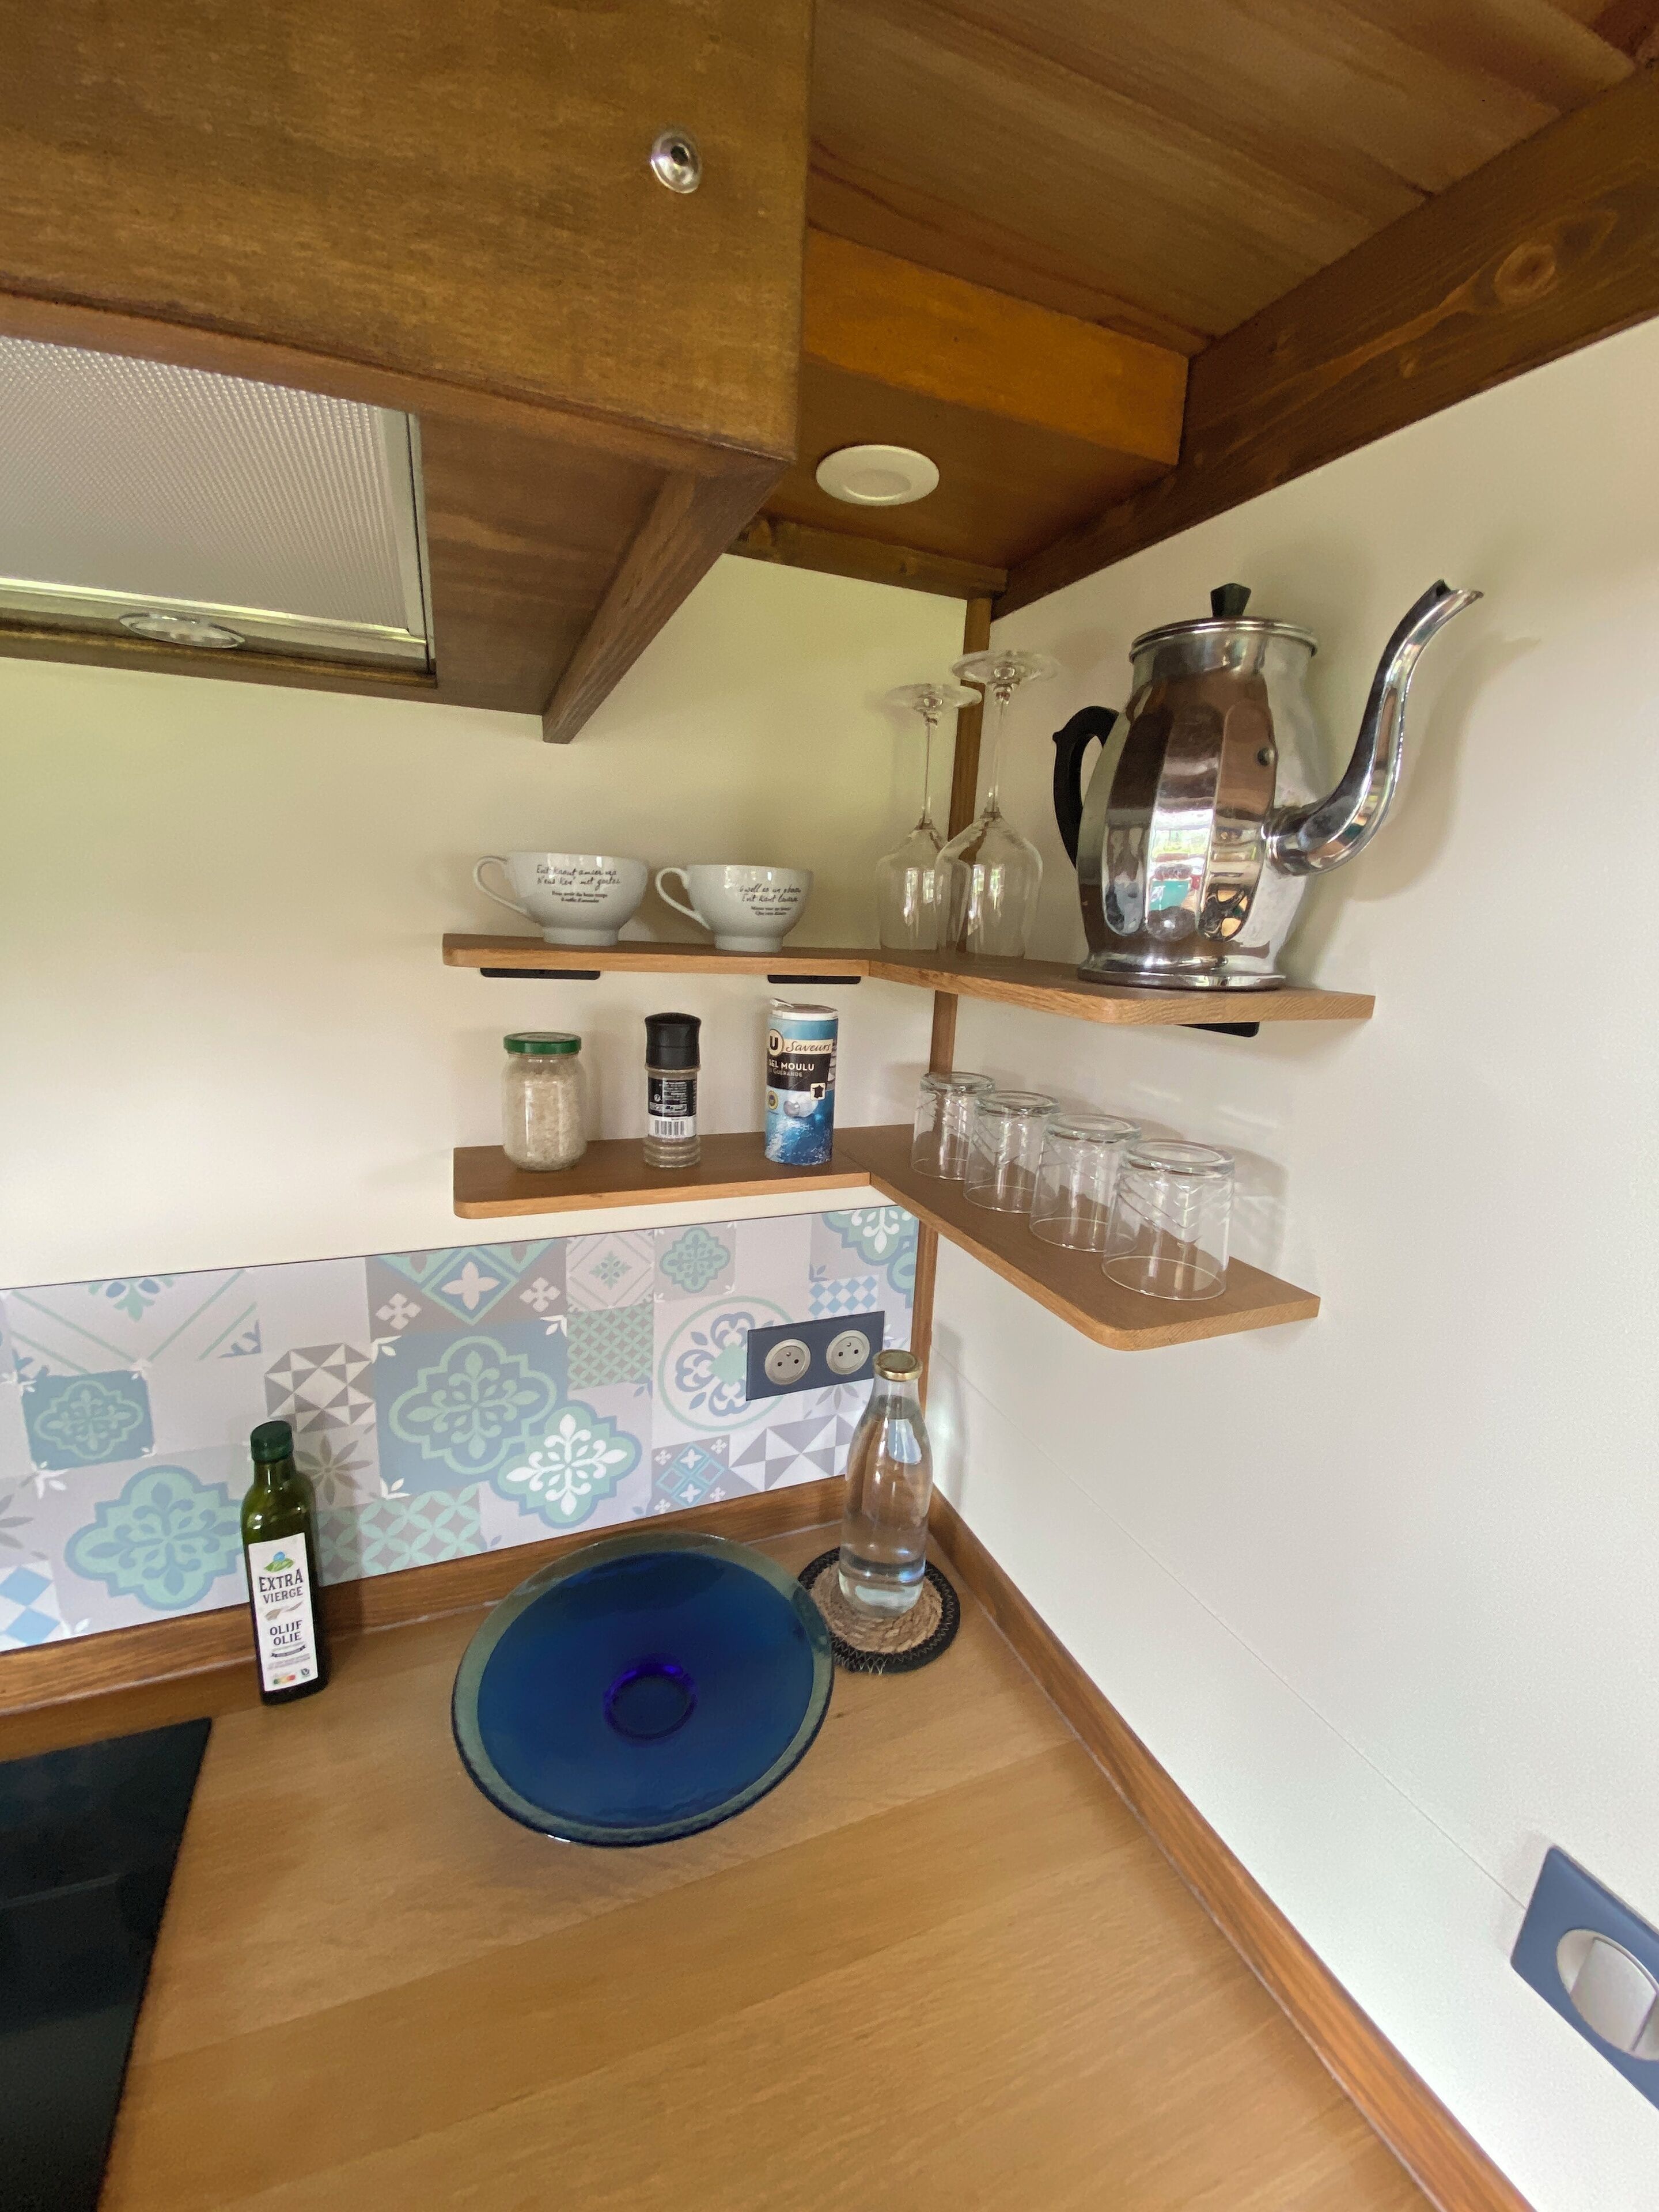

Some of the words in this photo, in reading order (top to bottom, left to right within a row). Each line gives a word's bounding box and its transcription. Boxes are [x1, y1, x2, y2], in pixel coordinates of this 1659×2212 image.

[770, 1036, 779, 1051] U
[786, 1040, 831, 1052] Saveurs
[781, 1062, 815, 1071] MOULU
[259, 1569, 304, 1592] EXTRA
[263, 1586, 304, 1604] VIERGE
[270, 1620, 303, 1636] OLIJF
[273, 1631, 302, 1646] OLIE
